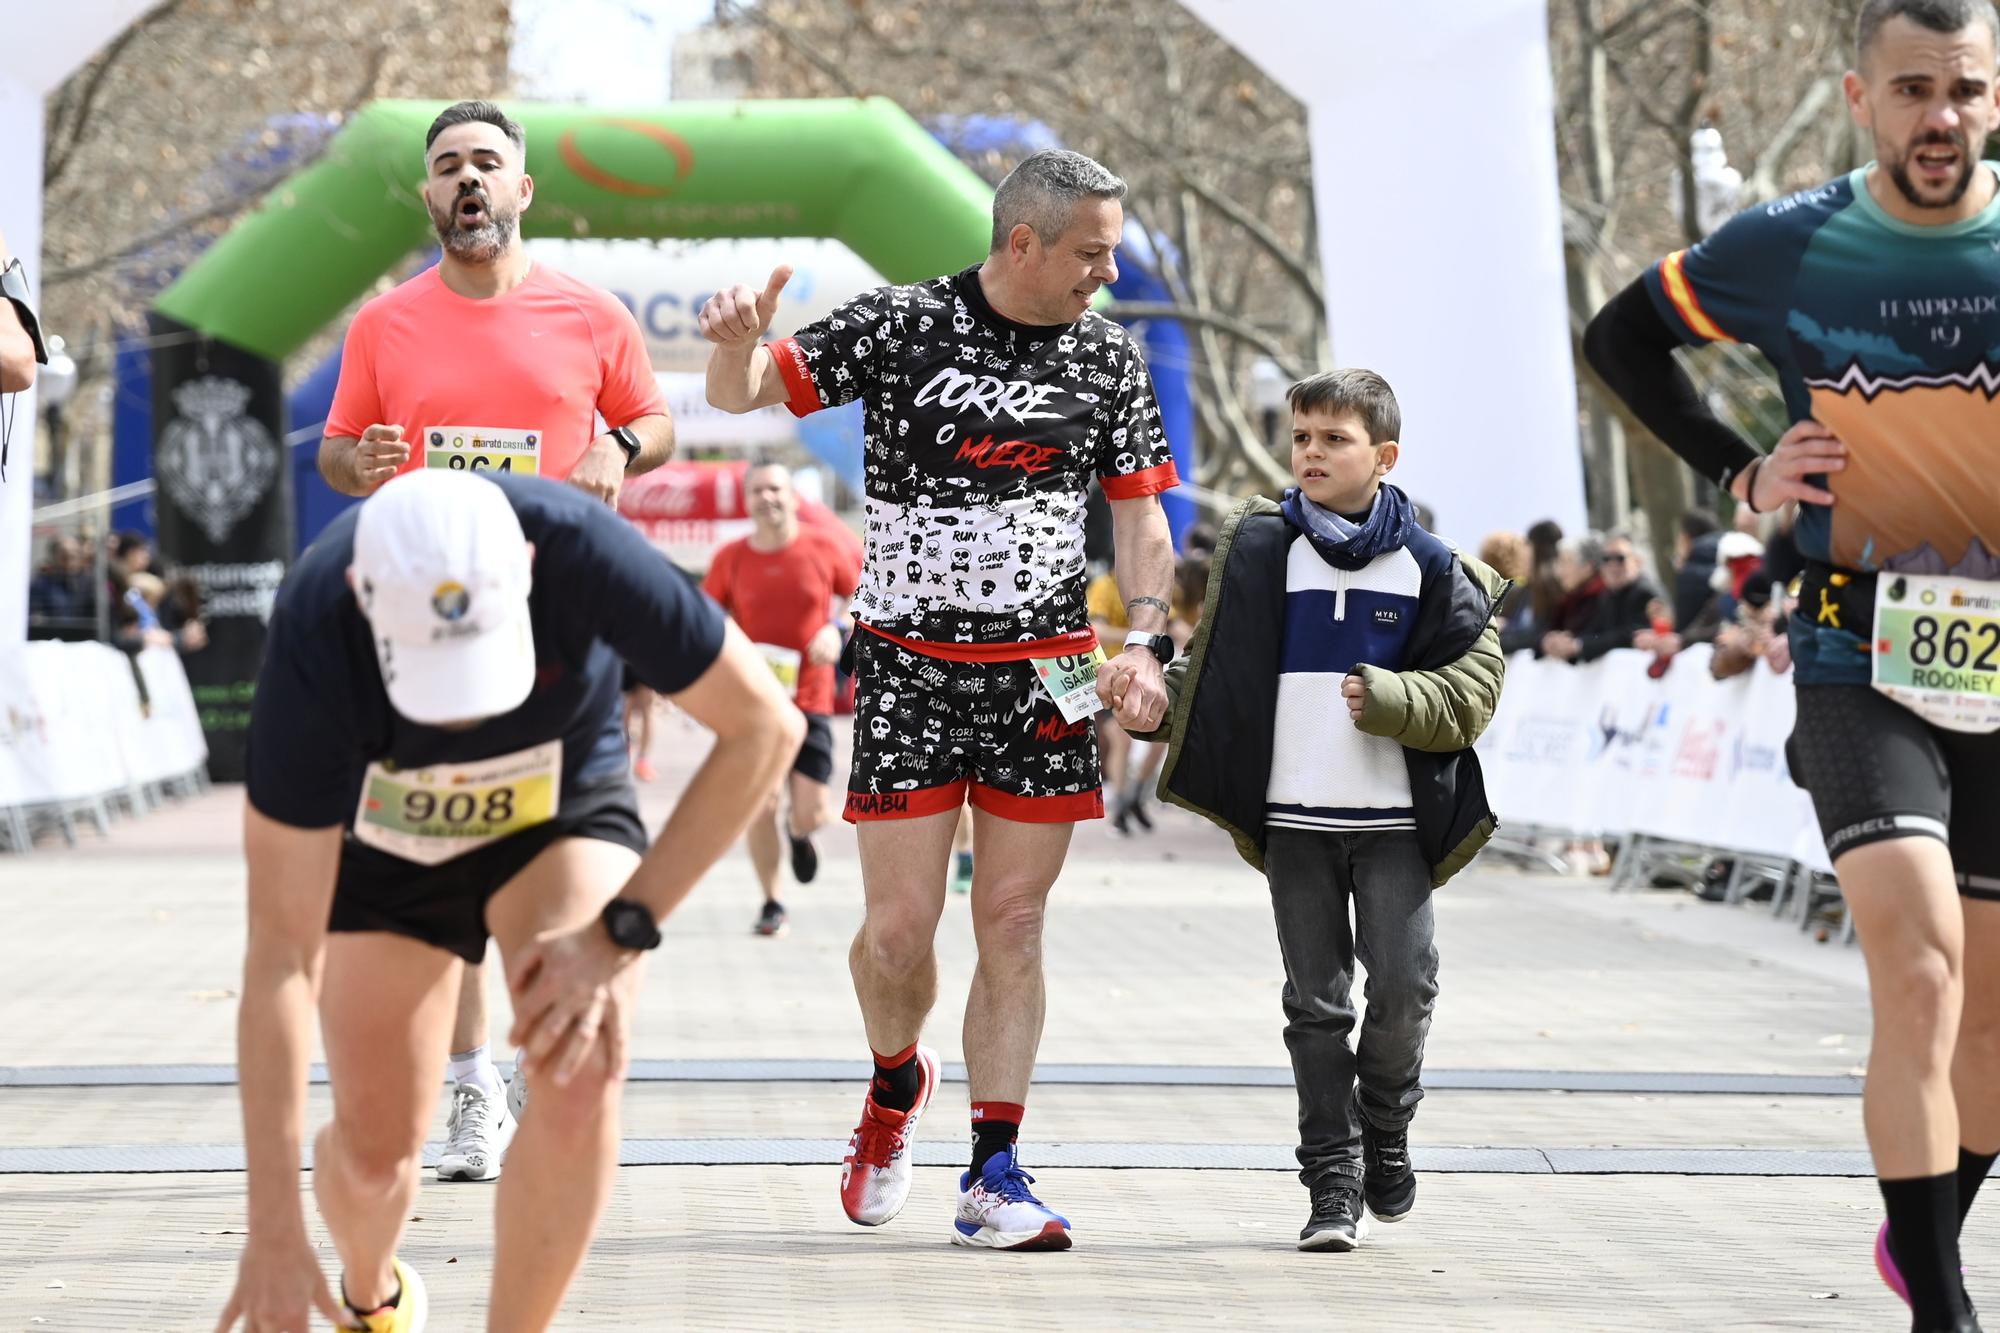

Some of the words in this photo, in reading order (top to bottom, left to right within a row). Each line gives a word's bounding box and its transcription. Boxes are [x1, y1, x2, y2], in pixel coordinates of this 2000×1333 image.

[853, 304, 880, 321] CORRE
[984, 354, 1012, 371] CORRE
[880, 371, 900, 384] RUN
[1087, 371, 1115, 390] CORRE
[914, 367, 1069, 427] CORRE
[1142, 405, 1160, 421] RUN
[936, 423, 956, 445] O
[954, 434, 1064, 475] MUERE
[875, 480, 889, 492] RUN
[964, 491, 990, 504] RUN
[952, 530, 978, 542] RUN
[881, 541, 905, 554] CORRE
[978, 550, 1011, 563] CORRE
[1375, 610, 1398, 620] MYRL
[981, 620, 1013, 633] CORRE
[1910, 615, 2000, 671] 862
[918, 664, 948, 687] CORRE
[1912, 668, 1994, 692] ROONEY
[928, 697, 952, 714] RUN
[973, 711, 998, 725] RUN
[902, 754, 930, 772] CORRE
[404, 787, 514, 824] 908
